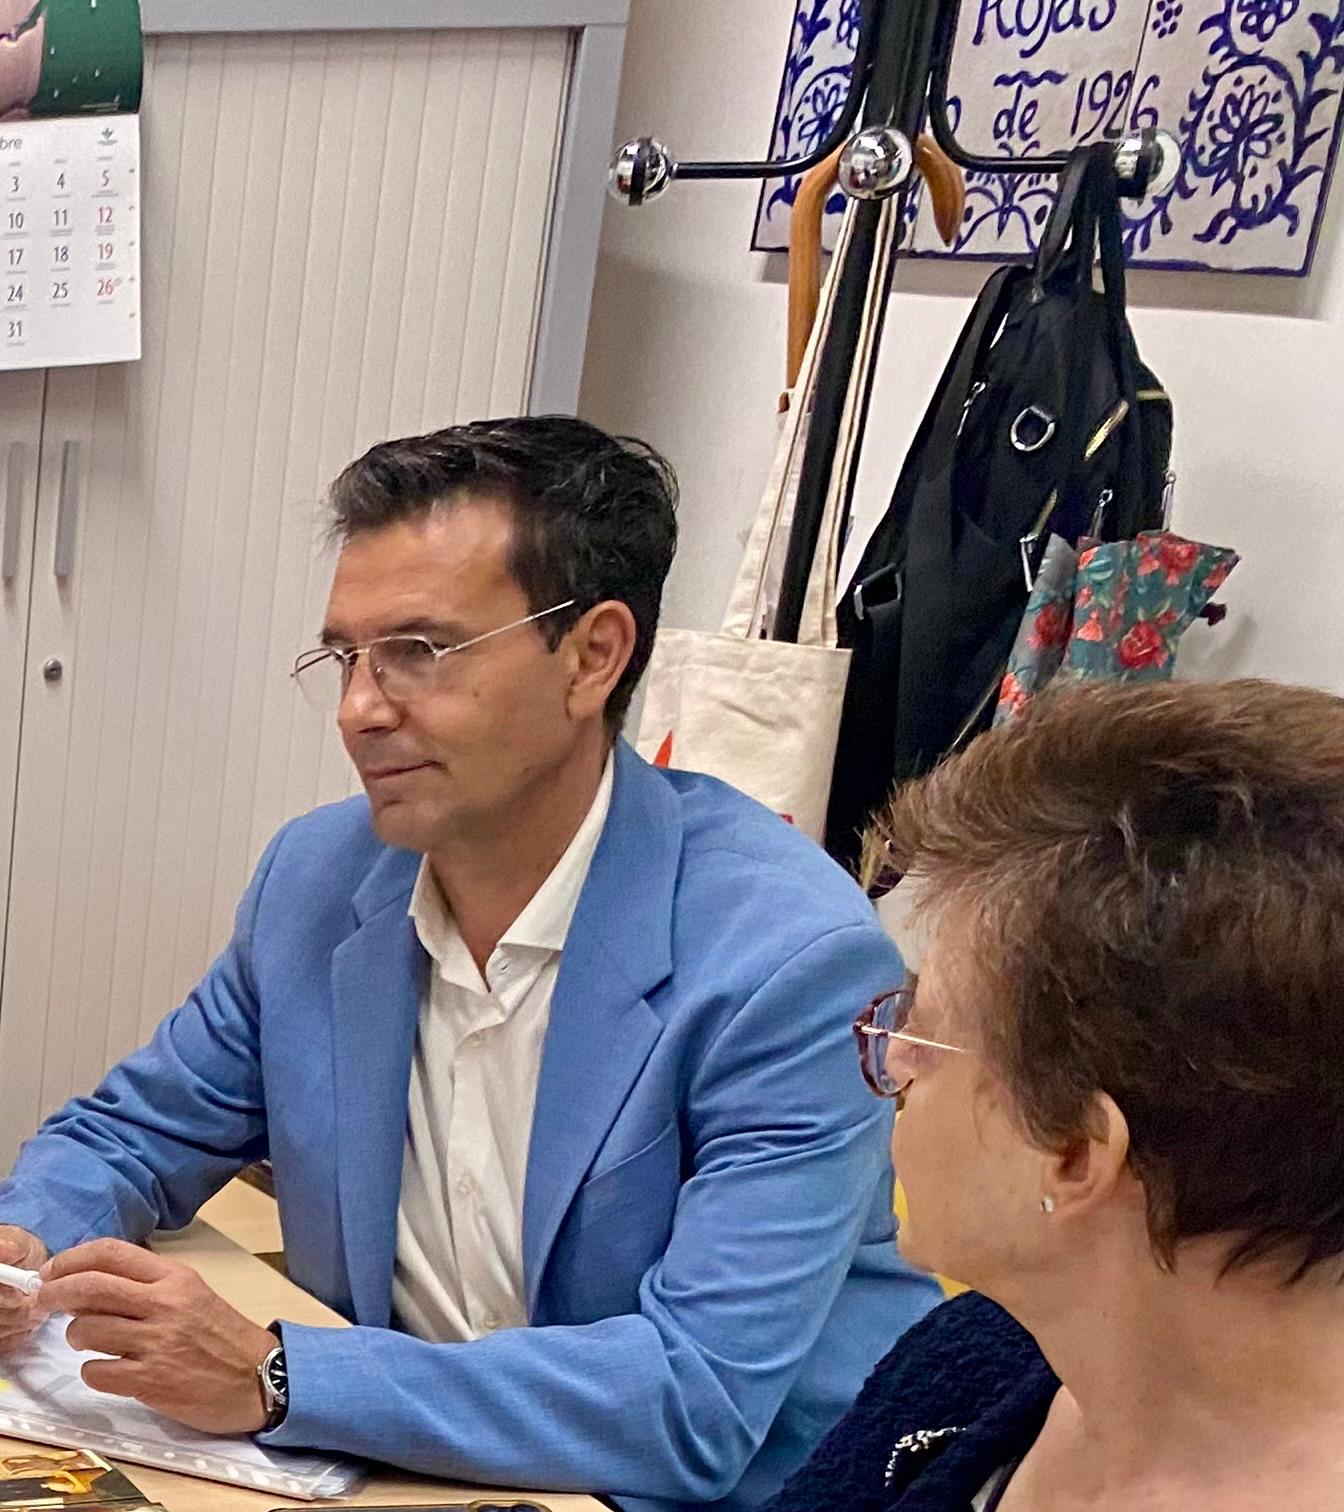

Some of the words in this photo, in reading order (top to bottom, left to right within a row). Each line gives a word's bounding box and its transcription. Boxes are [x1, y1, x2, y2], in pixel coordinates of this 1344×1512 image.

[993, 84, 1040, 141] de
[1070, 70, 1160, 143] 1926
[12, 176, 19, 192] 3
[56, 173, 65, 189] 4
[102, 169, 109, 187] 5
[8, 212, 24, 229] 10
[54, 209, 68, 226] 11
[98, 206, 113, 223] 12
[8, 248, 24, 265] 17
[54, 246, 69, 262] 18
[97, 243, 113, 260] 19
[8, 284, 23, 301] 24
[52, 282, 68, 299] 25
[97, 279, 113, 296] 26
[8, 320, 22, 338] 31
